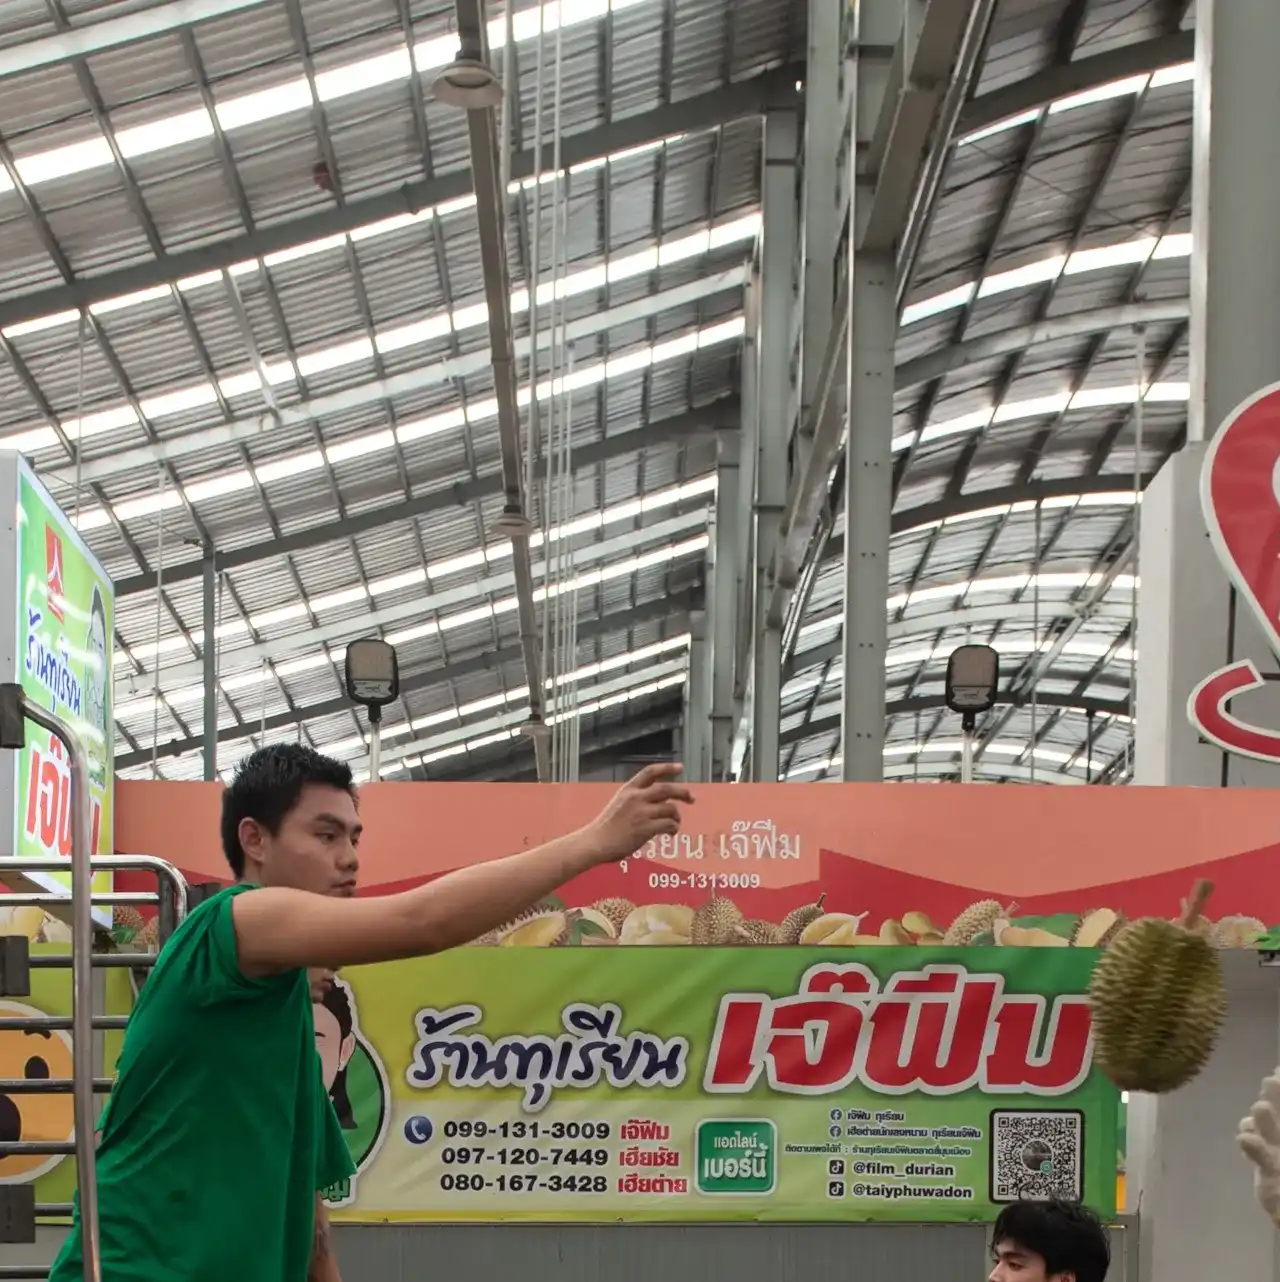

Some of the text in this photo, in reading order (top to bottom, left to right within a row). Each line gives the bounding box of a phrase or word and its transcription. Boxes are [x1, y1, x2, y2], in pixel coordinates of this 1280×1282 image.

[648, 873, 761, 889] 099-1313009
[412, 1008, 683, 1107] ร้านทุเรียน
[443, 1121, 611, 1139] 099-131-3009
[713, 1130, 758, 1149] แอดไลน์
[441, 1146, 680, 1167] 097-120-7449 เฮียชัย
[704, 1143, 769, 1178] เบอร์นี้
[853, 1161, 954, 1178] @film_durian
[440, 1173, 688, 1193] 080-167-3428 เฮียต่าย
[853, 1183, 973, 1199] @taiyphuwadon
